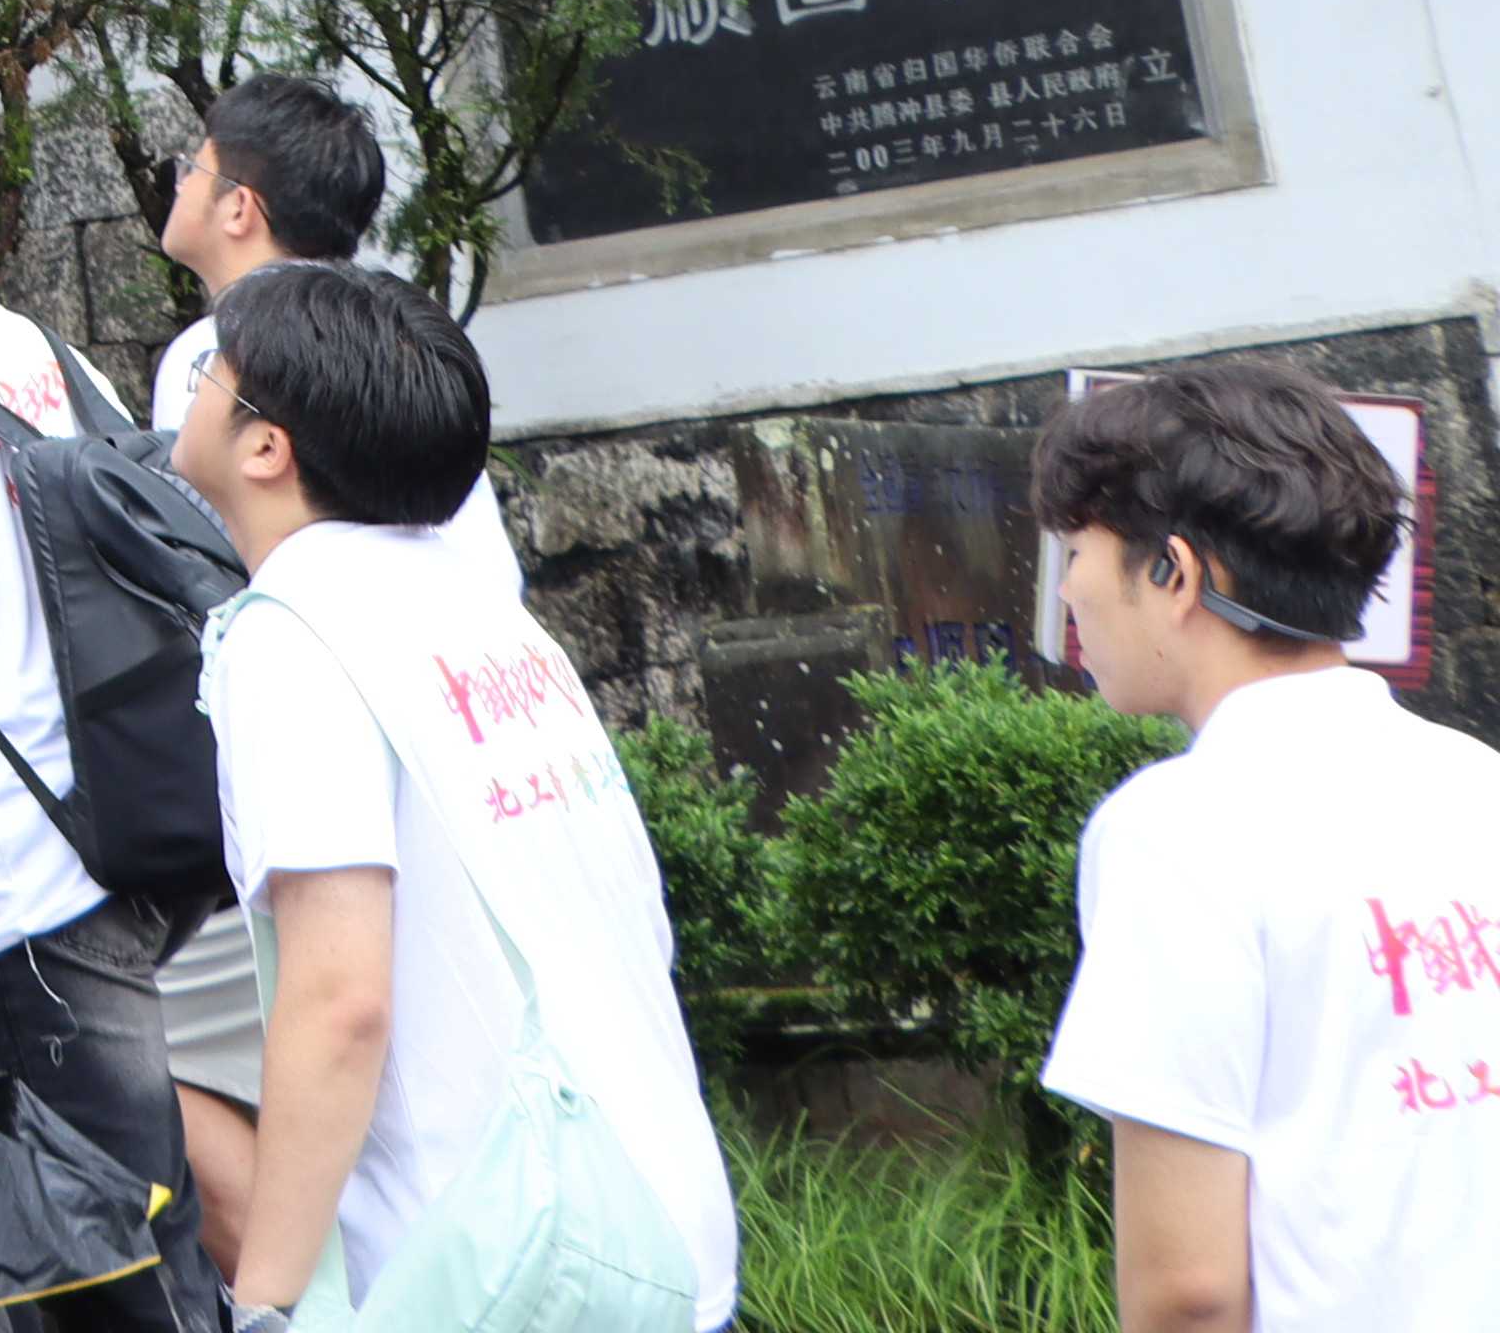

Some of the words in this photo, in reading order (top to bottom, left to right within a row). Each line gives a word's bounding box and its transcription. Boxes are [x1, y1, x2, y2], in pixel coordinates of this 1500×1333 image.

[813, 22, 1114, 101] 云南省归国华侨联合会
[819, 87, 975, 138] 中共腾冲县委
[988, 61, 1122, 110] 县人民政府
[1139, 47, 1180, 83] 立
